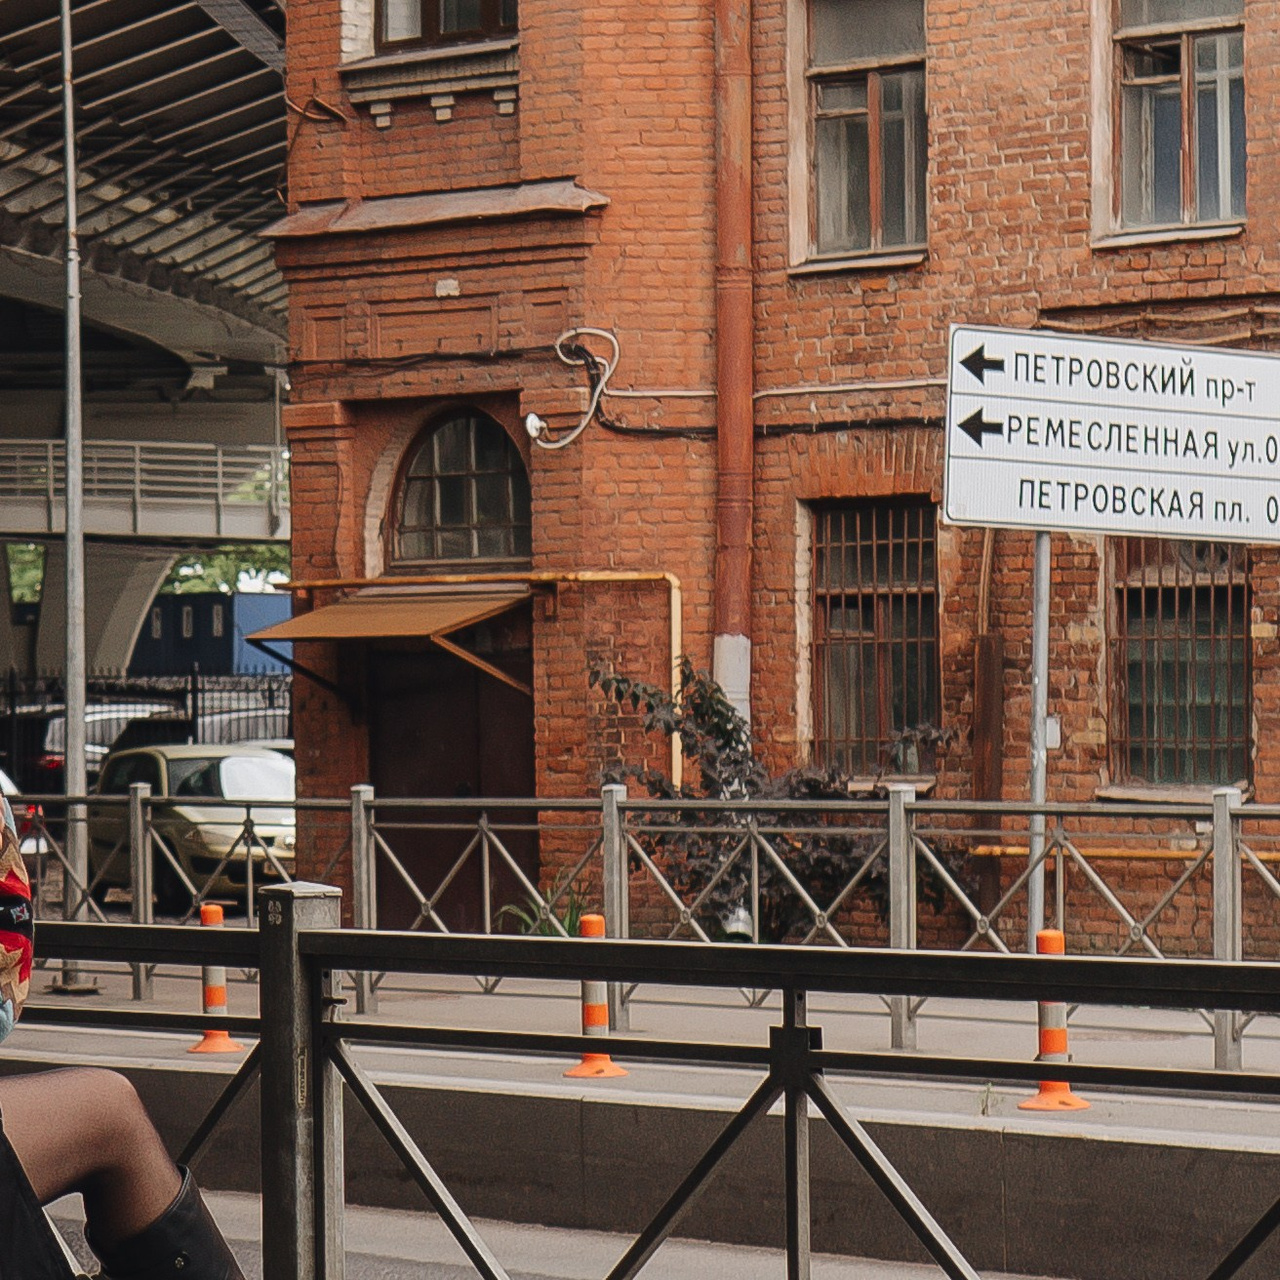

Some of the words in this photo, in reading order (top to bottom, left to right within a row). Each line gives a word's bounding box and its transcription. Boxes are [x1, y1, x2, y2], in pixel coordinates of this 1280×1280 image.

[1014, 351, 1195, 397] ПЕТРОВСКИЙ
[1206, 377, 1256, 408] пр-т
[1007, 414, 1218, 460] РЕМЕСЛЕННАЯ
[1019, 478, 1204, 520] ПЕТРОВСКАЯ
[1214, 500, 1250, 523] пл.
